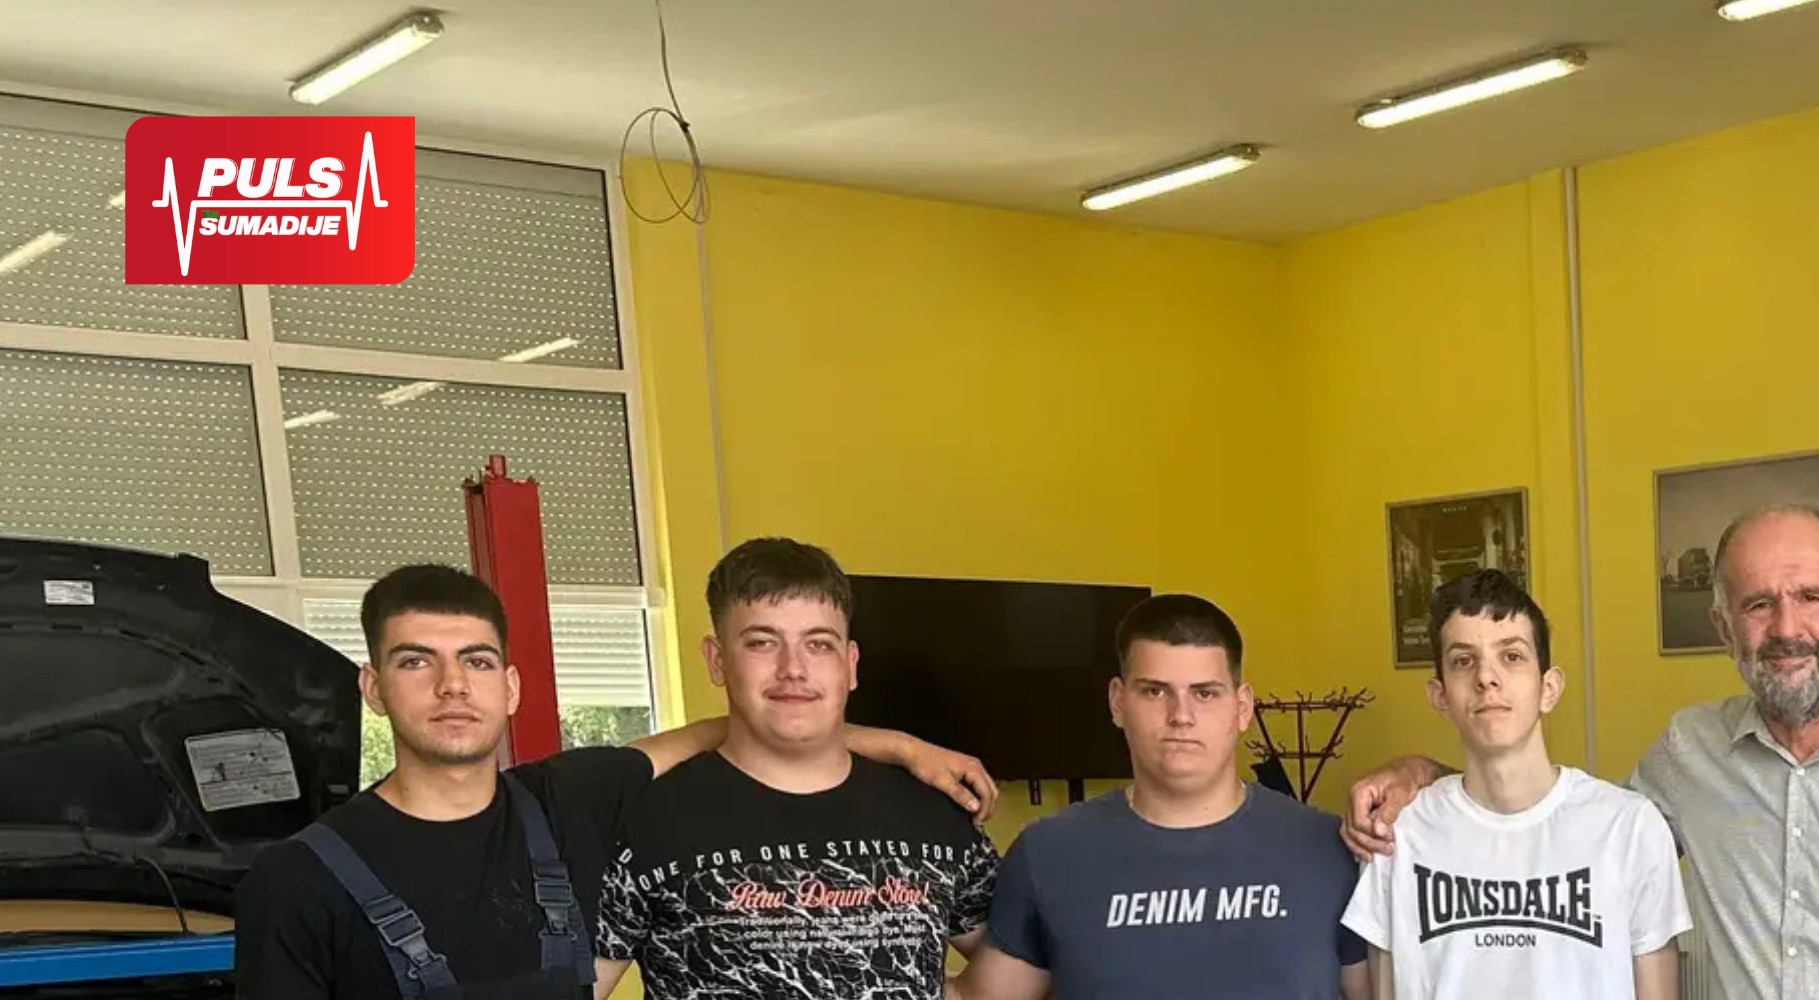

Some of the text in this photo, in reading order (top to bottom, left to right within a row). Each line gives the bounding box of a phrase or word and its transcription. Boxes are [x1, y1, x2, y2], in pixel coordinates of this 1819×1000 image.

[638, 861, 680, 891] ONE
[695, 848, 743, 868] FOR
[760, 843, 809, 861] ONE
[826, 840, 909, 857] STAYED
[922, 843, 953, 862] FOR
[1106, 884, 1288, 928] DENIM MFG.
[1413, 862, 1603, 948] LONSDALE
[1475, 933, 1537, 948] LONDON
